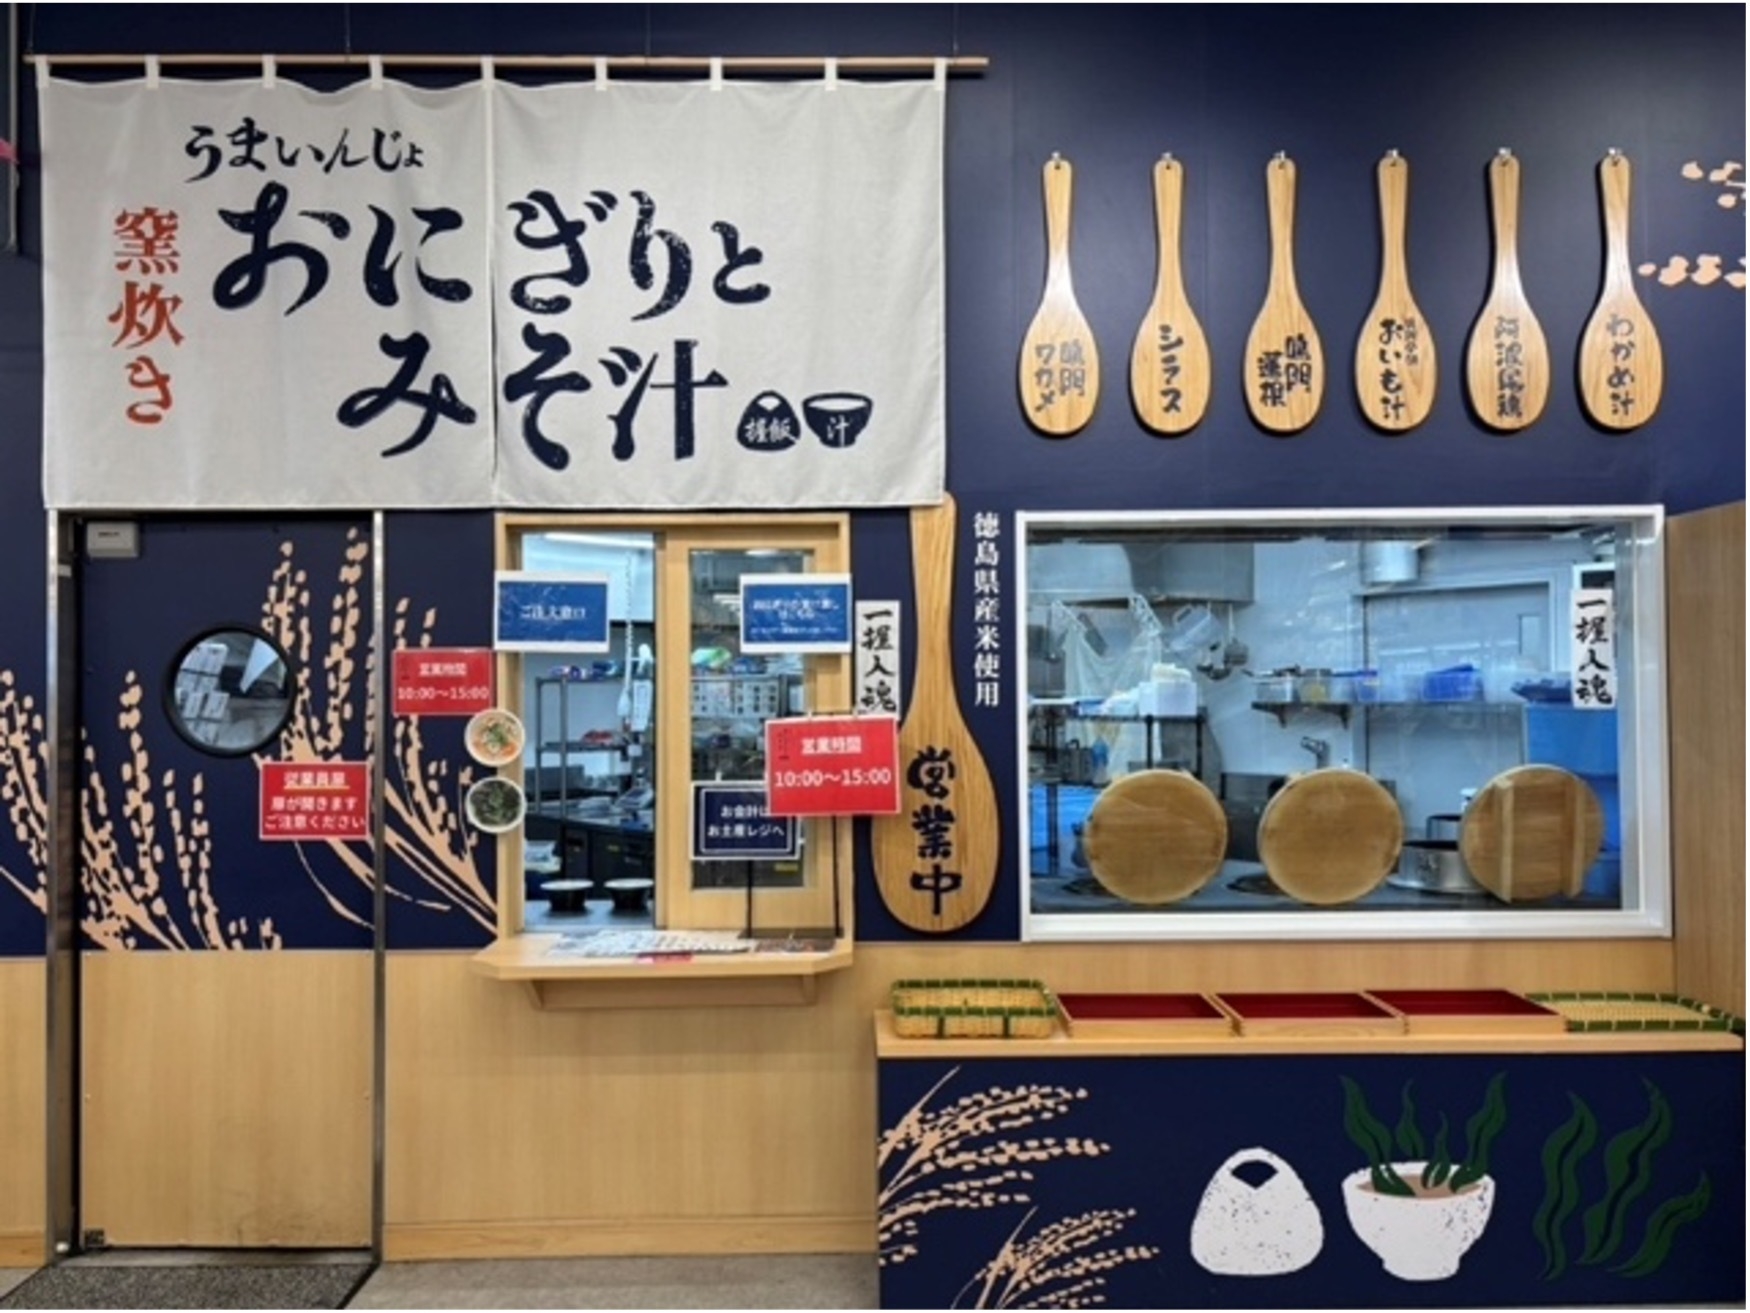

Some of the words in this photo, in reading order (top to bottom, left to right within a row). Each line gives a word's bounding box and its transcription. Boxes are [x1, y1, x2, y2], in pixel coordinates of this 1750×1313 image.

[184, 116, 424, 183] うまいんじょ
[212, 180, 771, 321] おにぎりと
[108, 206, 185, 425] 窯炊き
[337, 322, 728, 471] みそ汁
[1034, 342, 1056, 412] ワカメ
[1158, 323, 1184, 413] シラス
[1257, 350, 1287, 407] 蓮根
[1379, 318, 1404, 420] おいも汁
[1606, 314, 1635, 416] わかめ汁
[744, 416, 799, 443] 握飯
[826, 414, 850, 447] 汁
[973, 512, 1000, 706] 徳島県産米使用
[1575, 598, 1613, 705] 一握入魂
[860, 608, 897, 712] 一握入魂
[775, 767, 892, 787] 10:00～15:00
[801, 735, 862, 755] 営業時間
[264, 813, 367, 830] ご注意ください
[707, 823, 785, 838] お土産レジへ
[906, 745, 963, 916] 営業中
